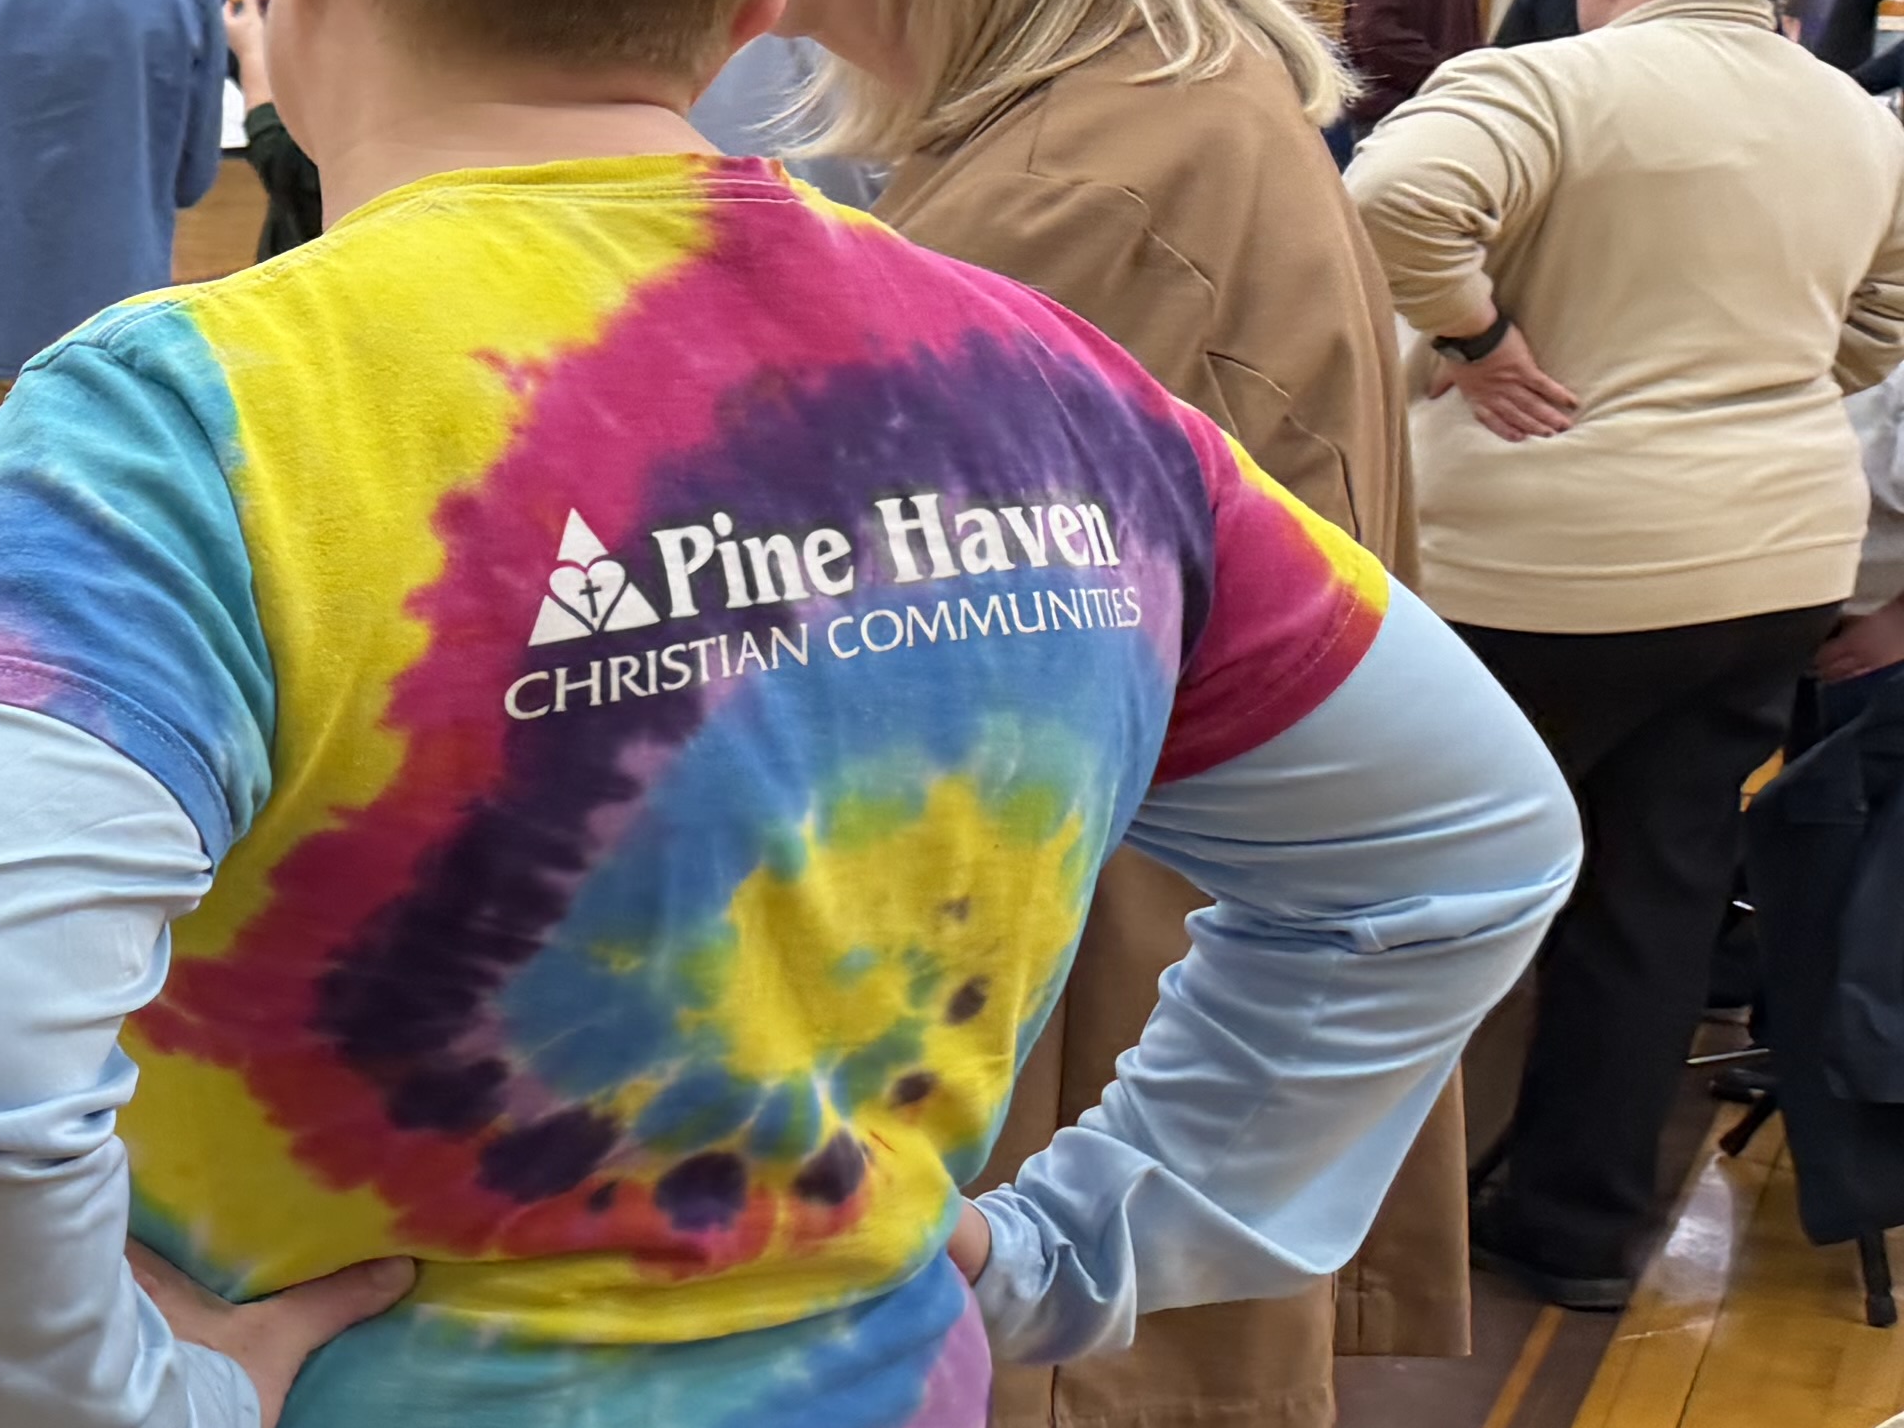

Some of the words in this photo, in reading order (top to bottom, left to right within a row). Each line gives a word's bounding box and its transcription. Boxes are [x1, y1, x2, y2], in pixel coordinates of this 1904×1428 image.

[651, 512, 853, 619] Pine
[874, 492, 1120, 586] Haven
[503, 622, 808, 721] CHRISTIAN
[827, 585, 1141, 660] COMMUNITIES
